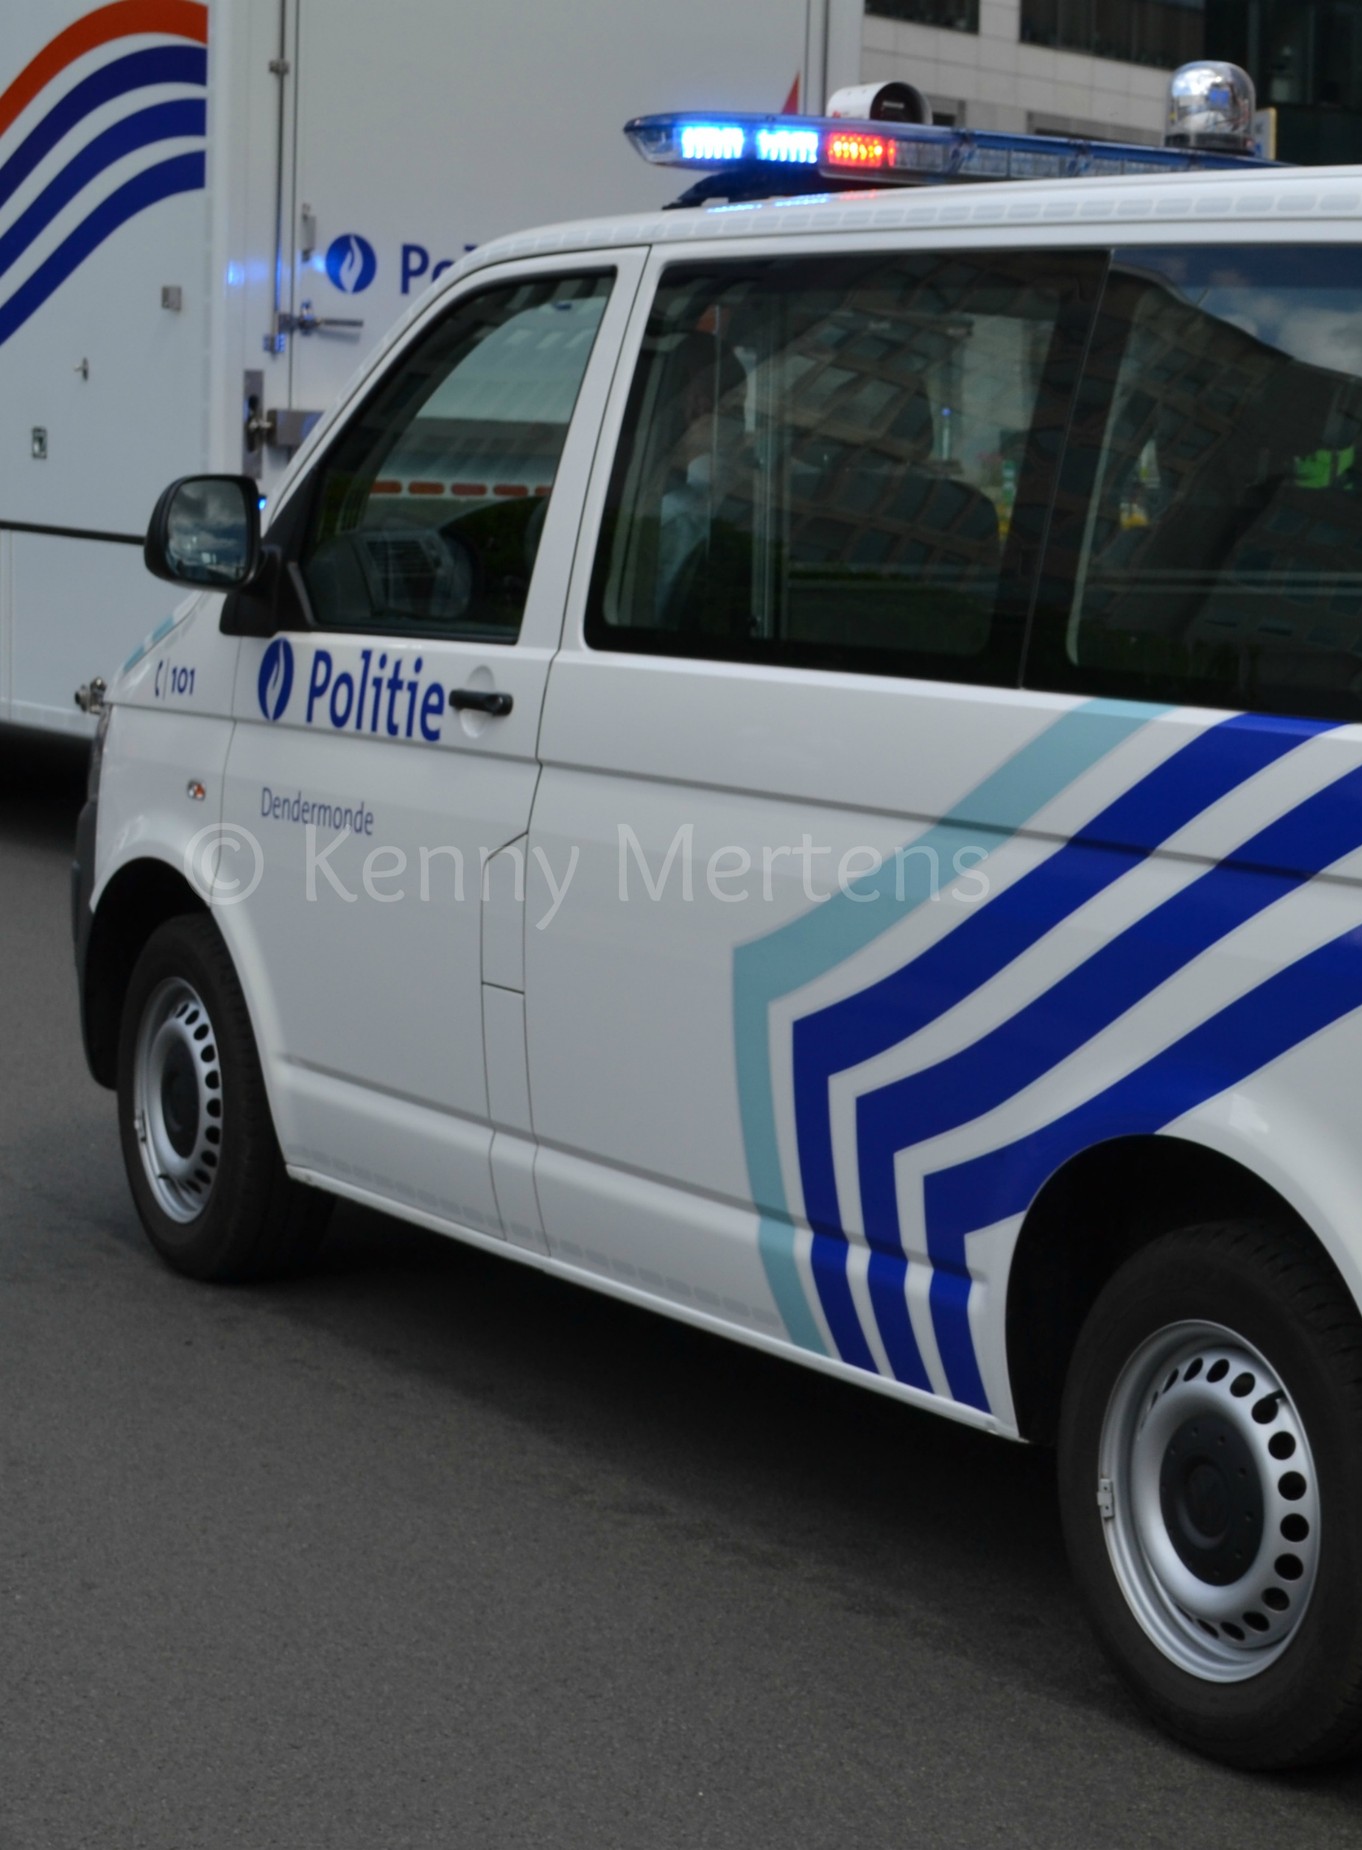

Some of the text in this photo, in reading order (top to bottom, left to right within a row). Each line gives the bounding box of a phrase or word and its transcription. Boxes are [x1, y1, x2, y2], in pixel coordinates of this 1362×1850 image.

[170, 666, 196, 697] 101
[306, 648, 446, 743] Politie
[260, 786, 375, 836] Dendermonde
